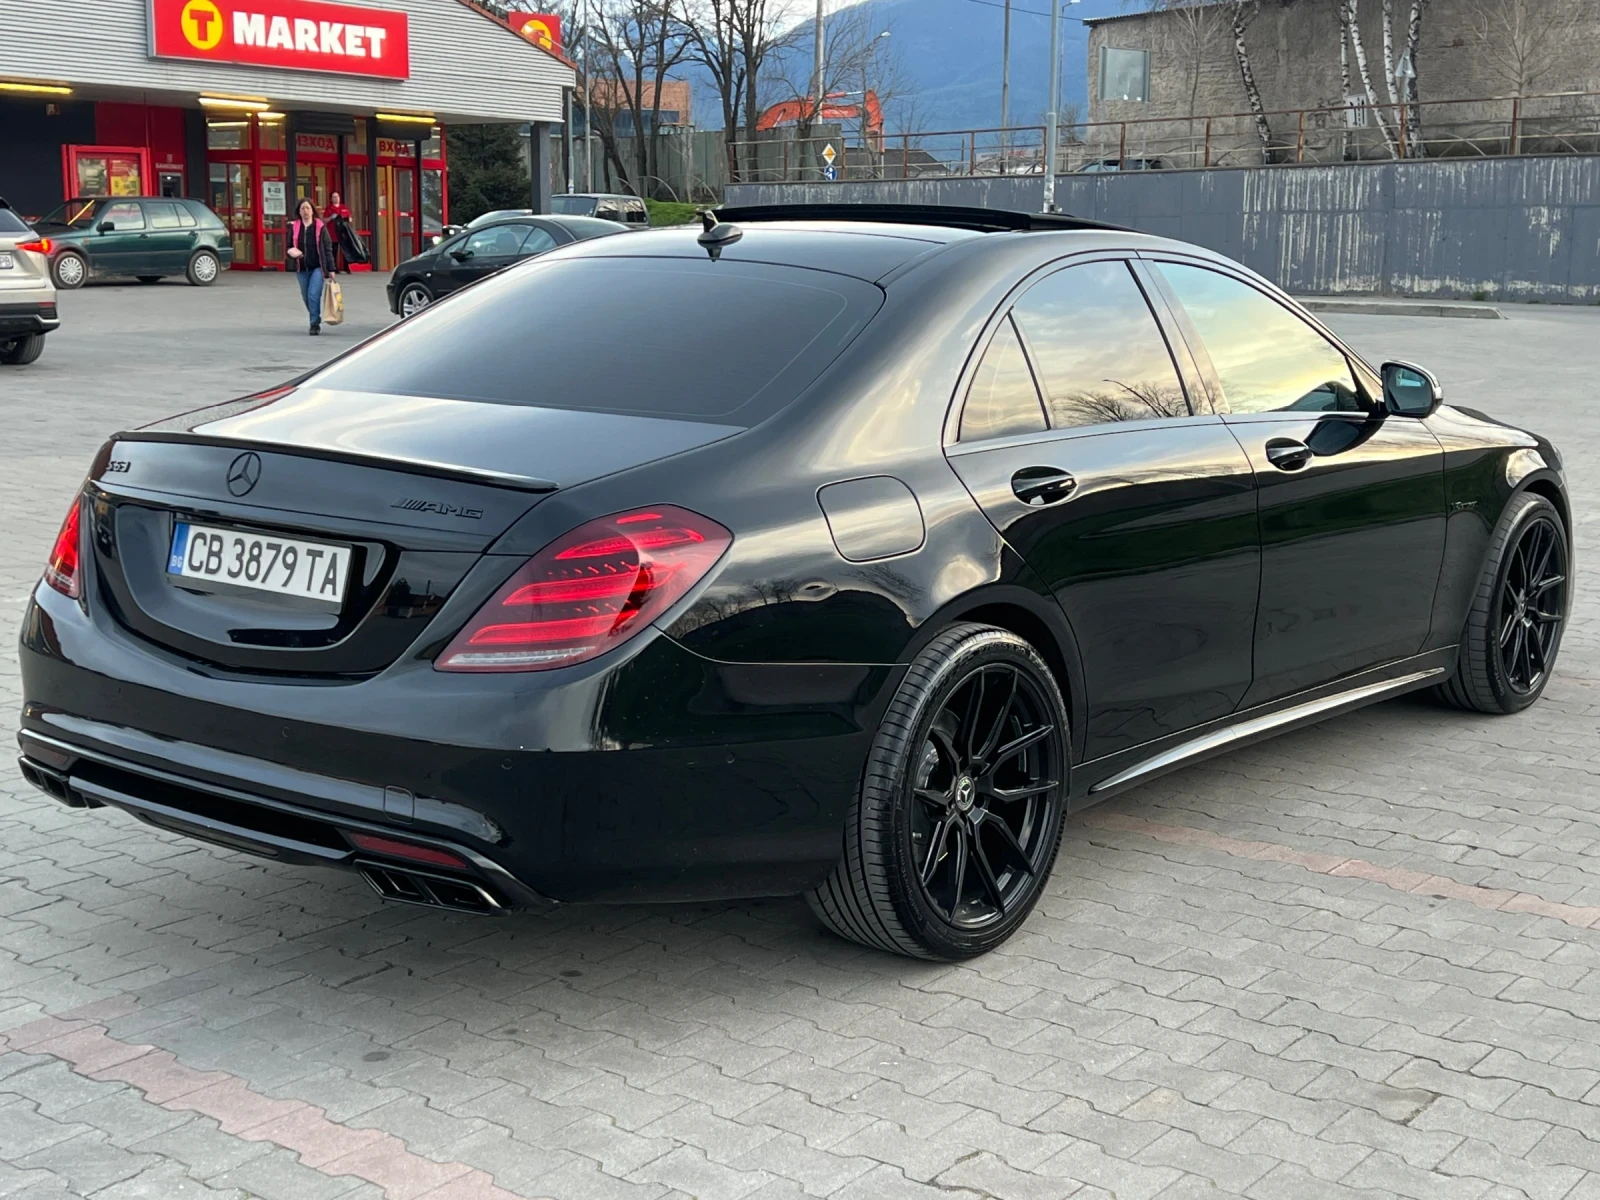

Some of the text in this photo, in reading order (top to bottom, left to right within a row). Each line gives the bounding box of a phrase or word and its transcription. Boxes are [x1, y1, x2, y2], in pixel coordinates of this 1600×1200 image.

[189, 9, 387, 59] T MARKET
[379, 140, 410, 154] ВХОД
[421, 500, 484, 519] AMG
[170, 555, 183, 568] BG
[188, 531, 338, 596] CB 3879 TA
